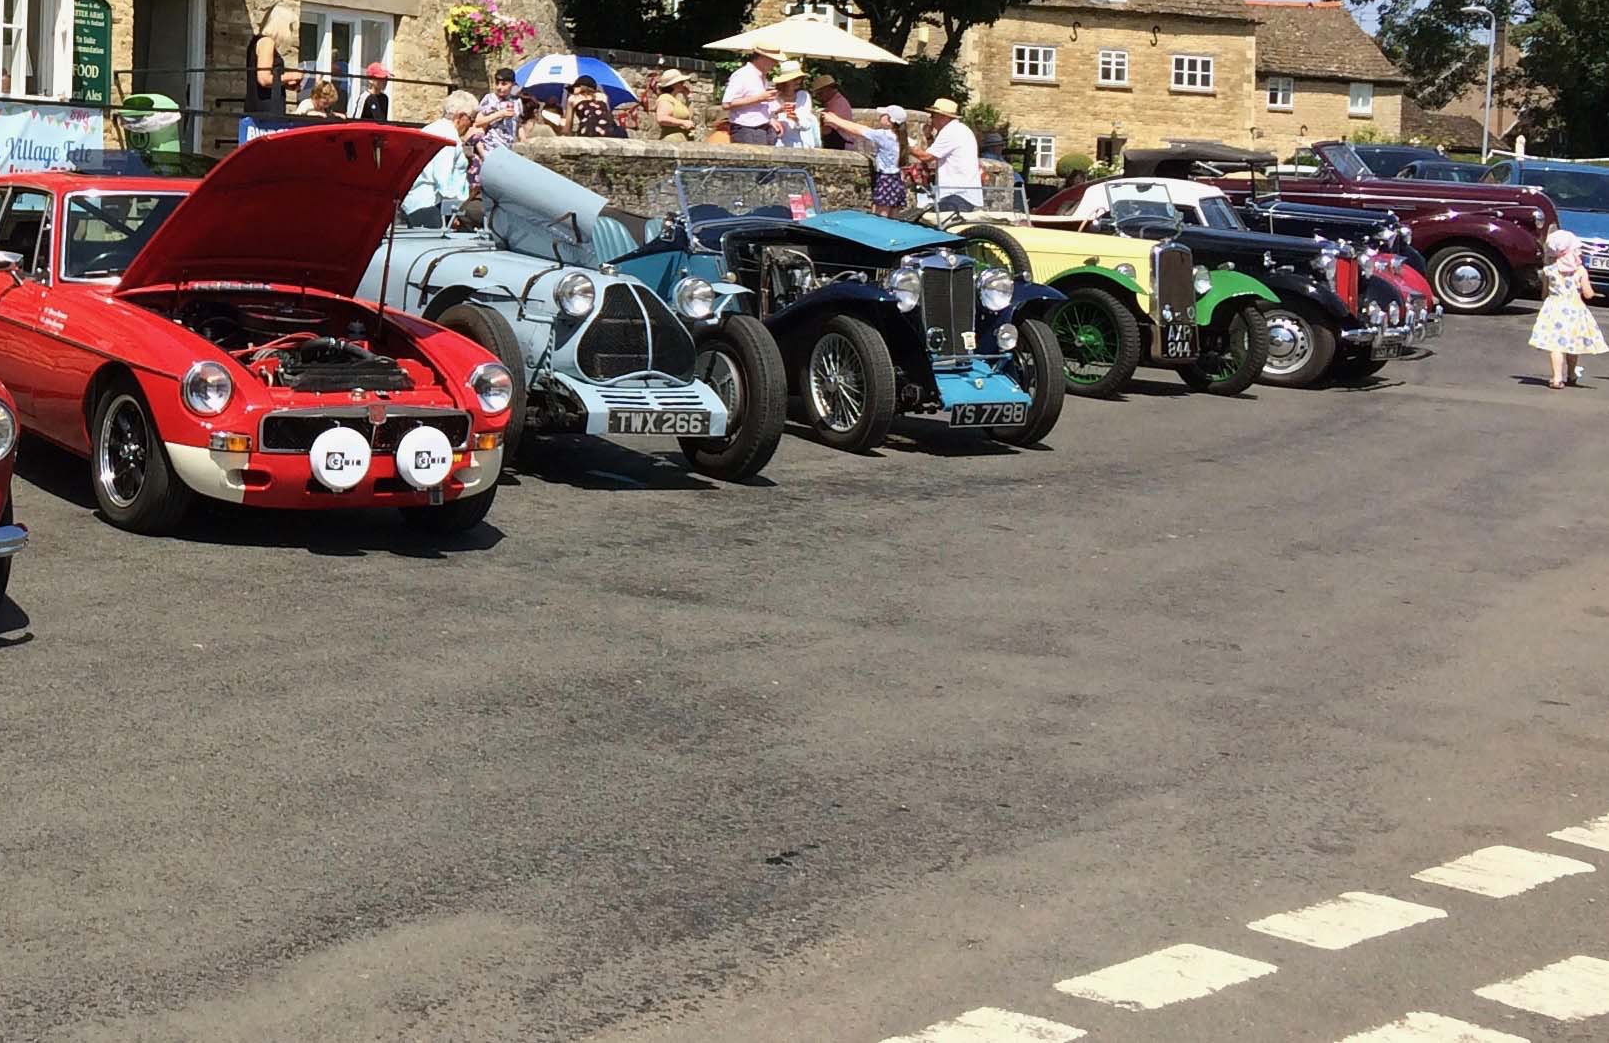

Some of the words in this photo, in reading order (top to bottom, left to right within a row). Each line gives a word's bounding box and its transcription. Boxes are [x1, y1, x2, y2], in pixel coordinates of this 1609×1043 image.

[85, 89, 102, 101] Ales
[6, 137, 60, 168] Village
[1167, 324, 1190, 341] AXP
[1168, 341, 1191, 357] 844
[617, 412, 657, 433] TWX
[661, 413, 703, 433] 266
[955, 404, 975, 425] YS
[980, 404, 1025, 424] 7798
